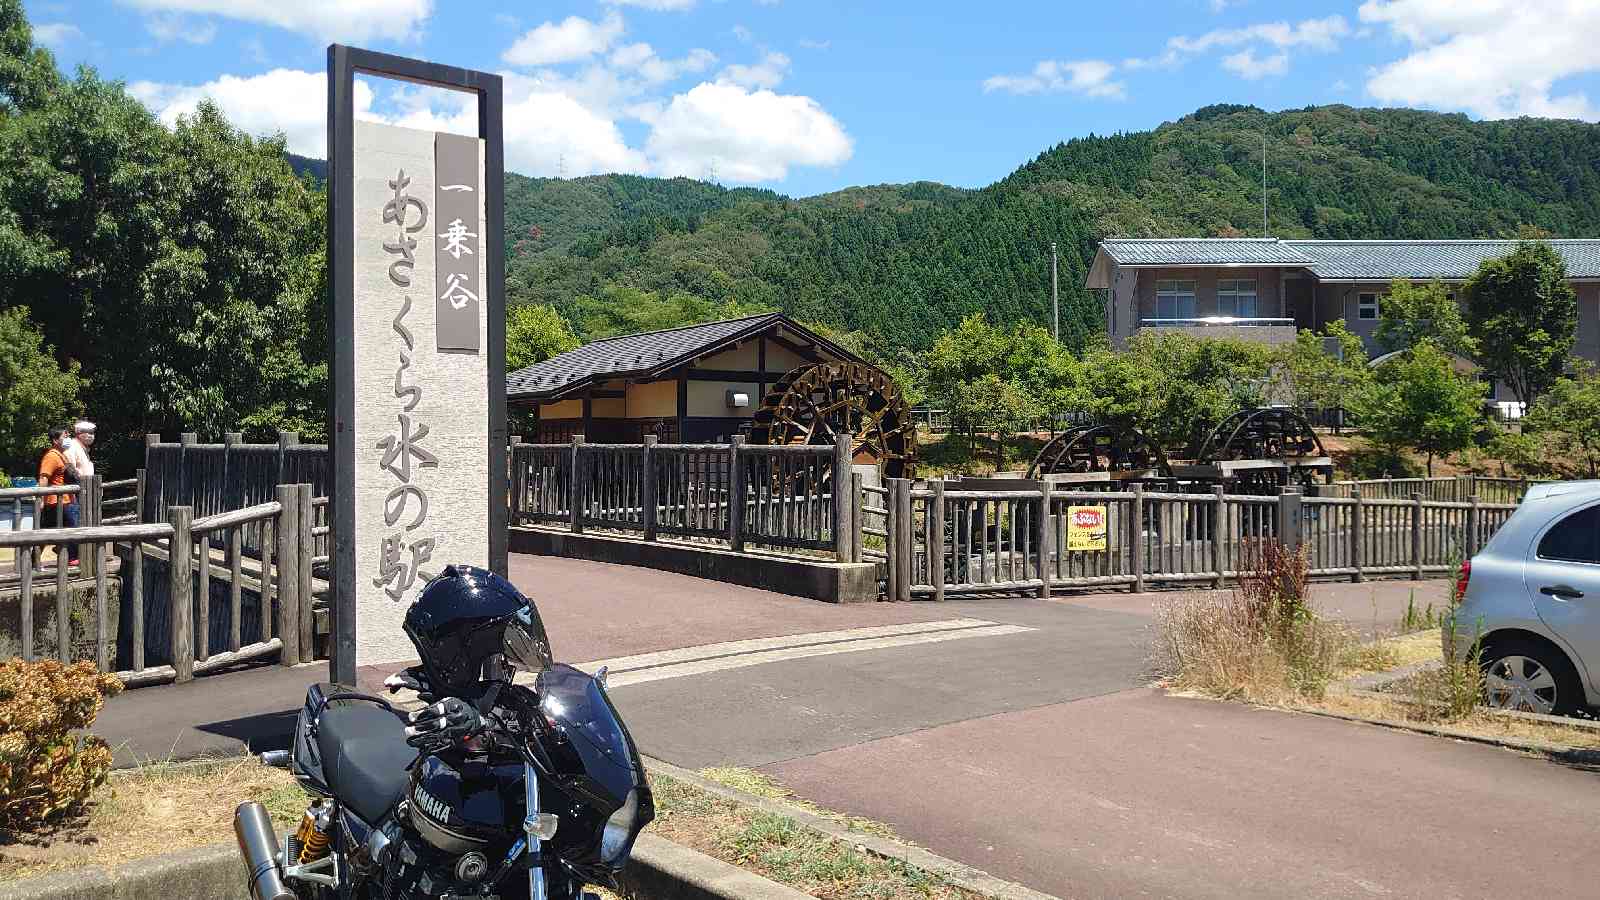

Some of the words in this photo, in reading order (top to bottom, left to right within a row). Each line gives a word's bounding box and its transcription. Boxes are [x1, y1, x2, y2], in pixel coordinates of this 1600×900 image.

[439, 185, 478, 310] 一乗谷
[373, 168, 438, 602] あさくら水の駅
[414, 782, 451, 824] YAMAHA
